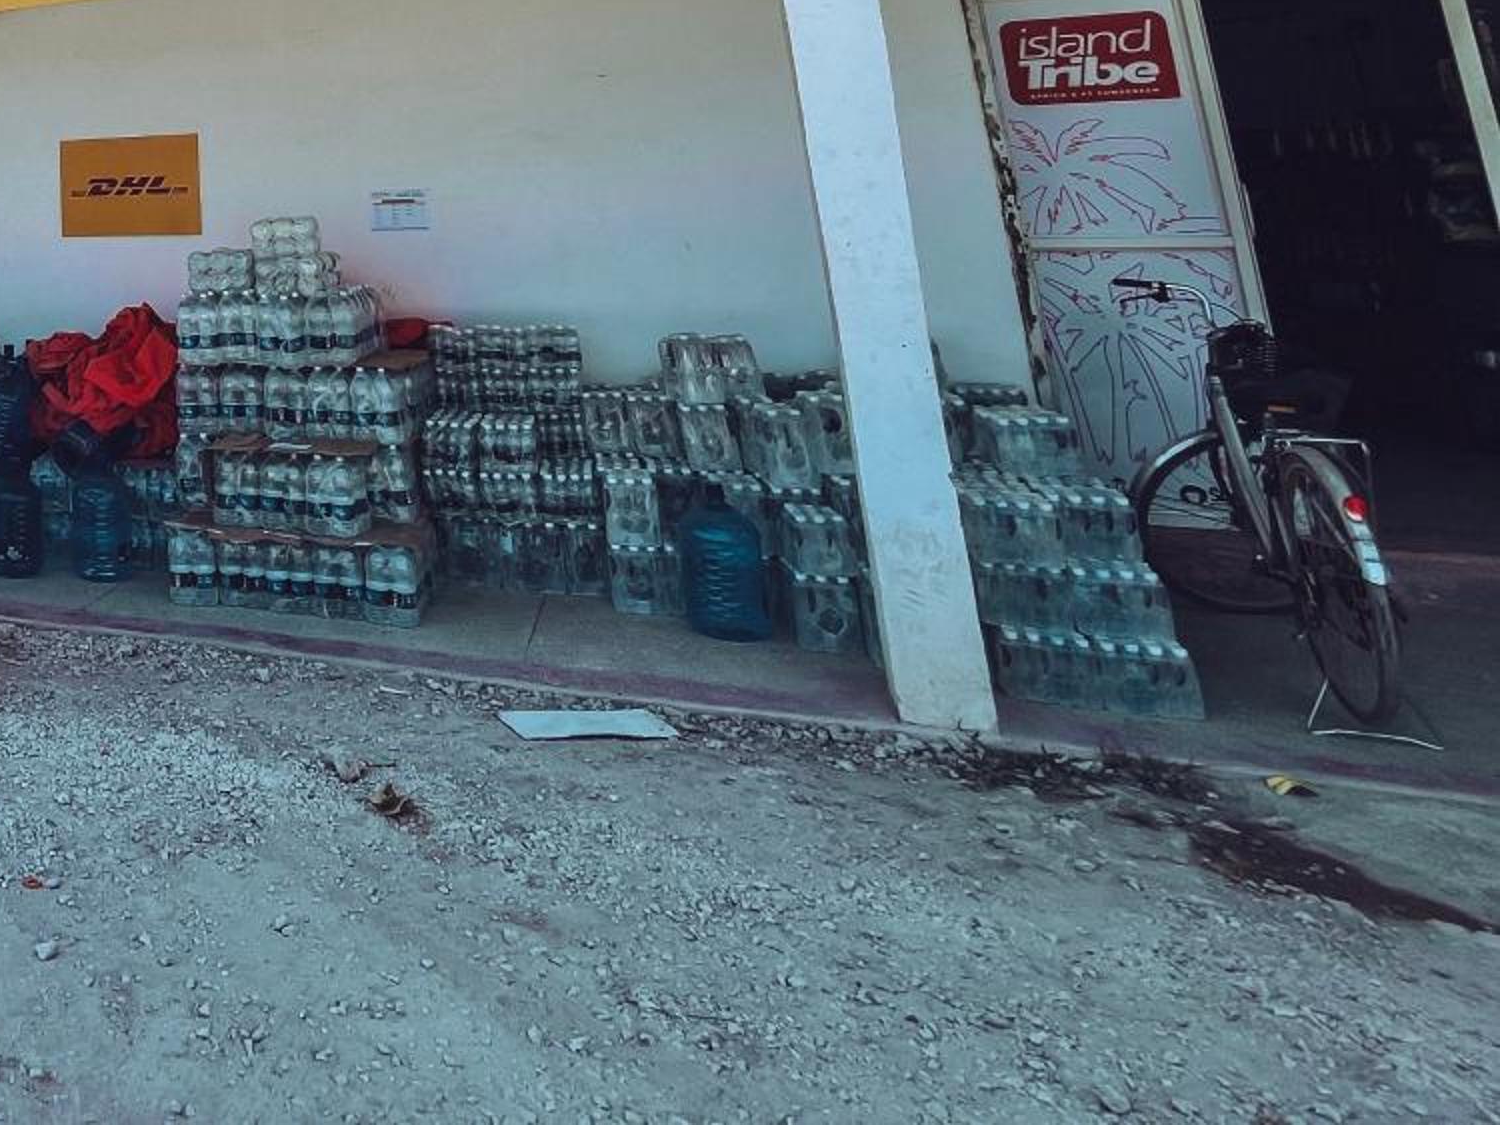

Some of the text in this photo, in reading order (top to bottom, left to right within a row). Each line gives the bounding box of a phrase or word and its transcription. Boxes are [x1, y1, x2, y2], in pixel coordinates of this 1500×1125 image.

[1018, 17, 1152, 61] island
[1017, 55, 1161, 90] Tribe
[86, 175, 172, 196] DHL
